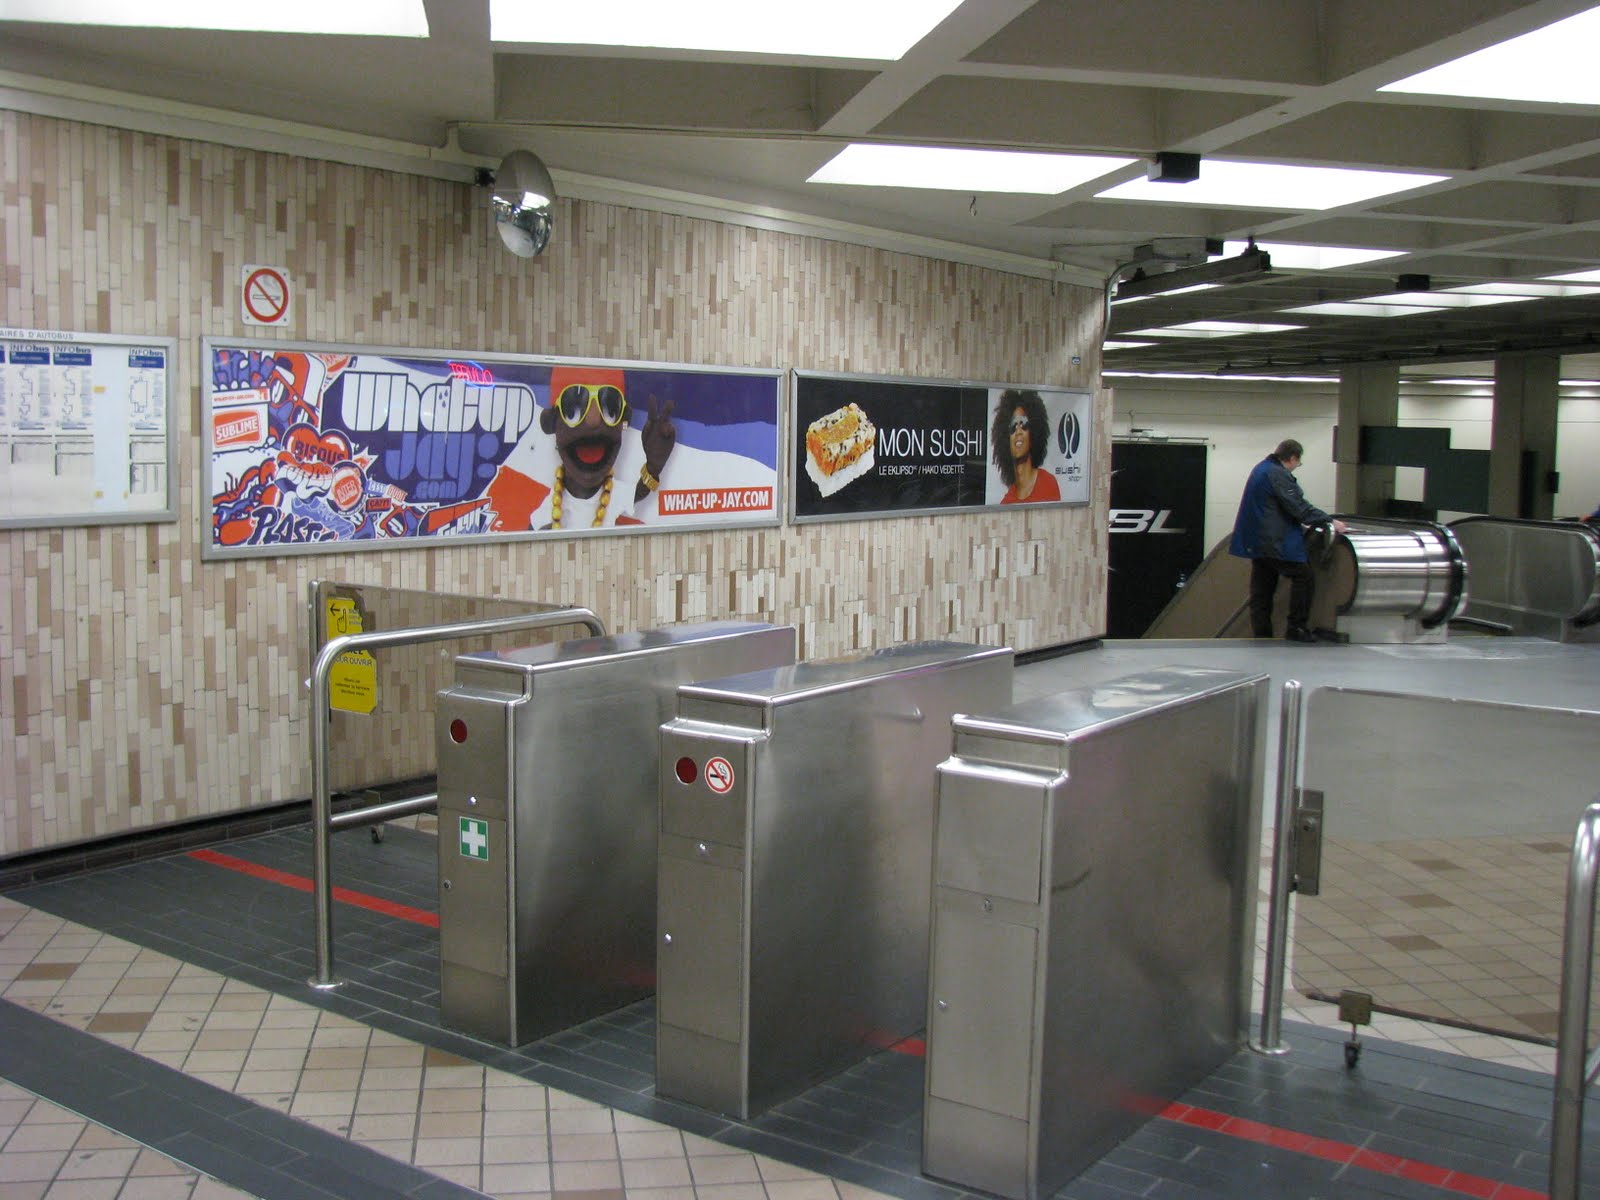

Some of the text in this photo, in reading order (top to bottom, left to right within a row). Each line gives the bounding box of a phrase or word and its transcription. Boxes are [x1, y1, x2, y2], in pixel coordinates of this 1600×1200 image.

[216, 418, 258, 441] SUBLIME
[879, 428, 983, 457] MON SUSHI
[879, 465, 887, 476] LE
[922, 465, 939, 475] HAKO
[940, 464, 965, 475] VEDETTE
[663, 490, 769, 511] WHAT-UP-JAY.COM
